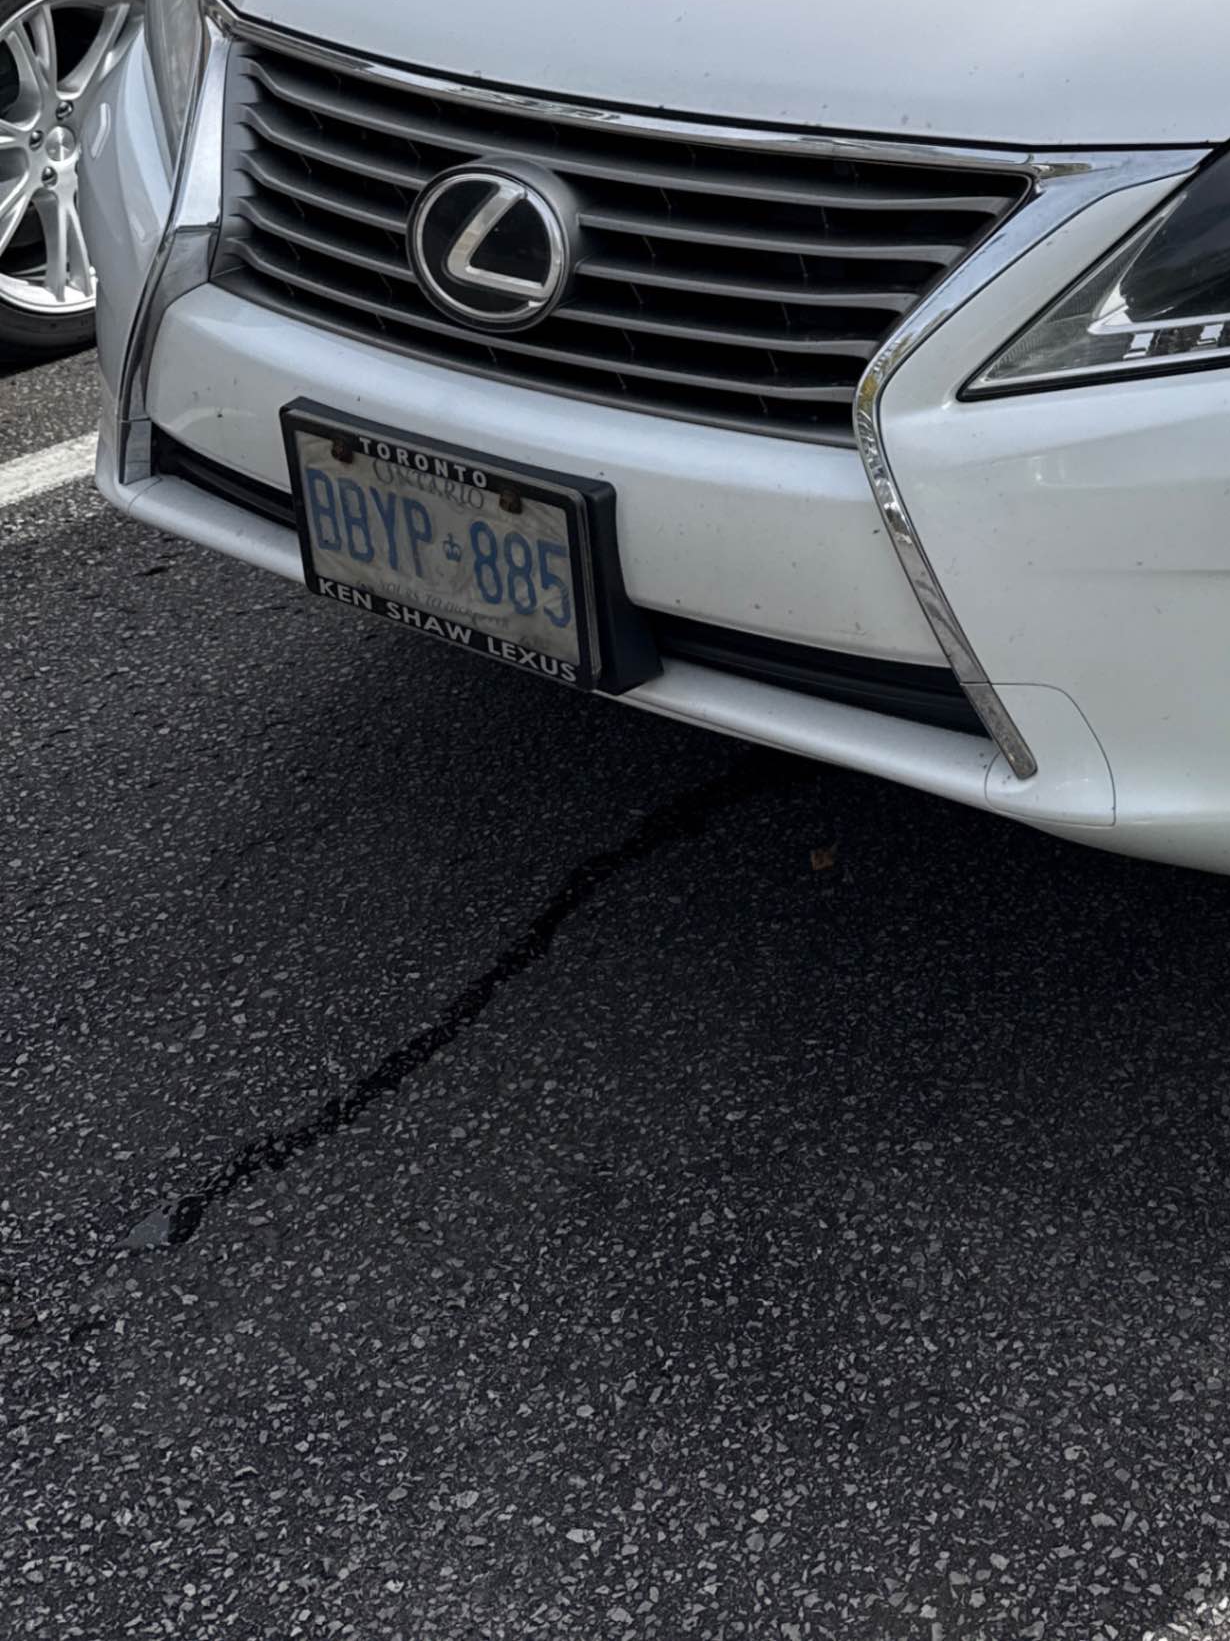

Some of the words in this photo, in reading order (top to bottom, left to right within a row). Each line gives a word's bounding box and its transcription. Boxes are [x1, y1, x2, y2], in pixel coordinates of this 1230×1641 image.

[360, 437, 488, 488] TORONTO
[305, 468, 433, 578] BBYP
[469, 520, 573, 629] 885
[318, 577, 373, 611] KEN
[387, 601, 472, 646] SHAW
[486, 636, 577, 682] LEXUS
